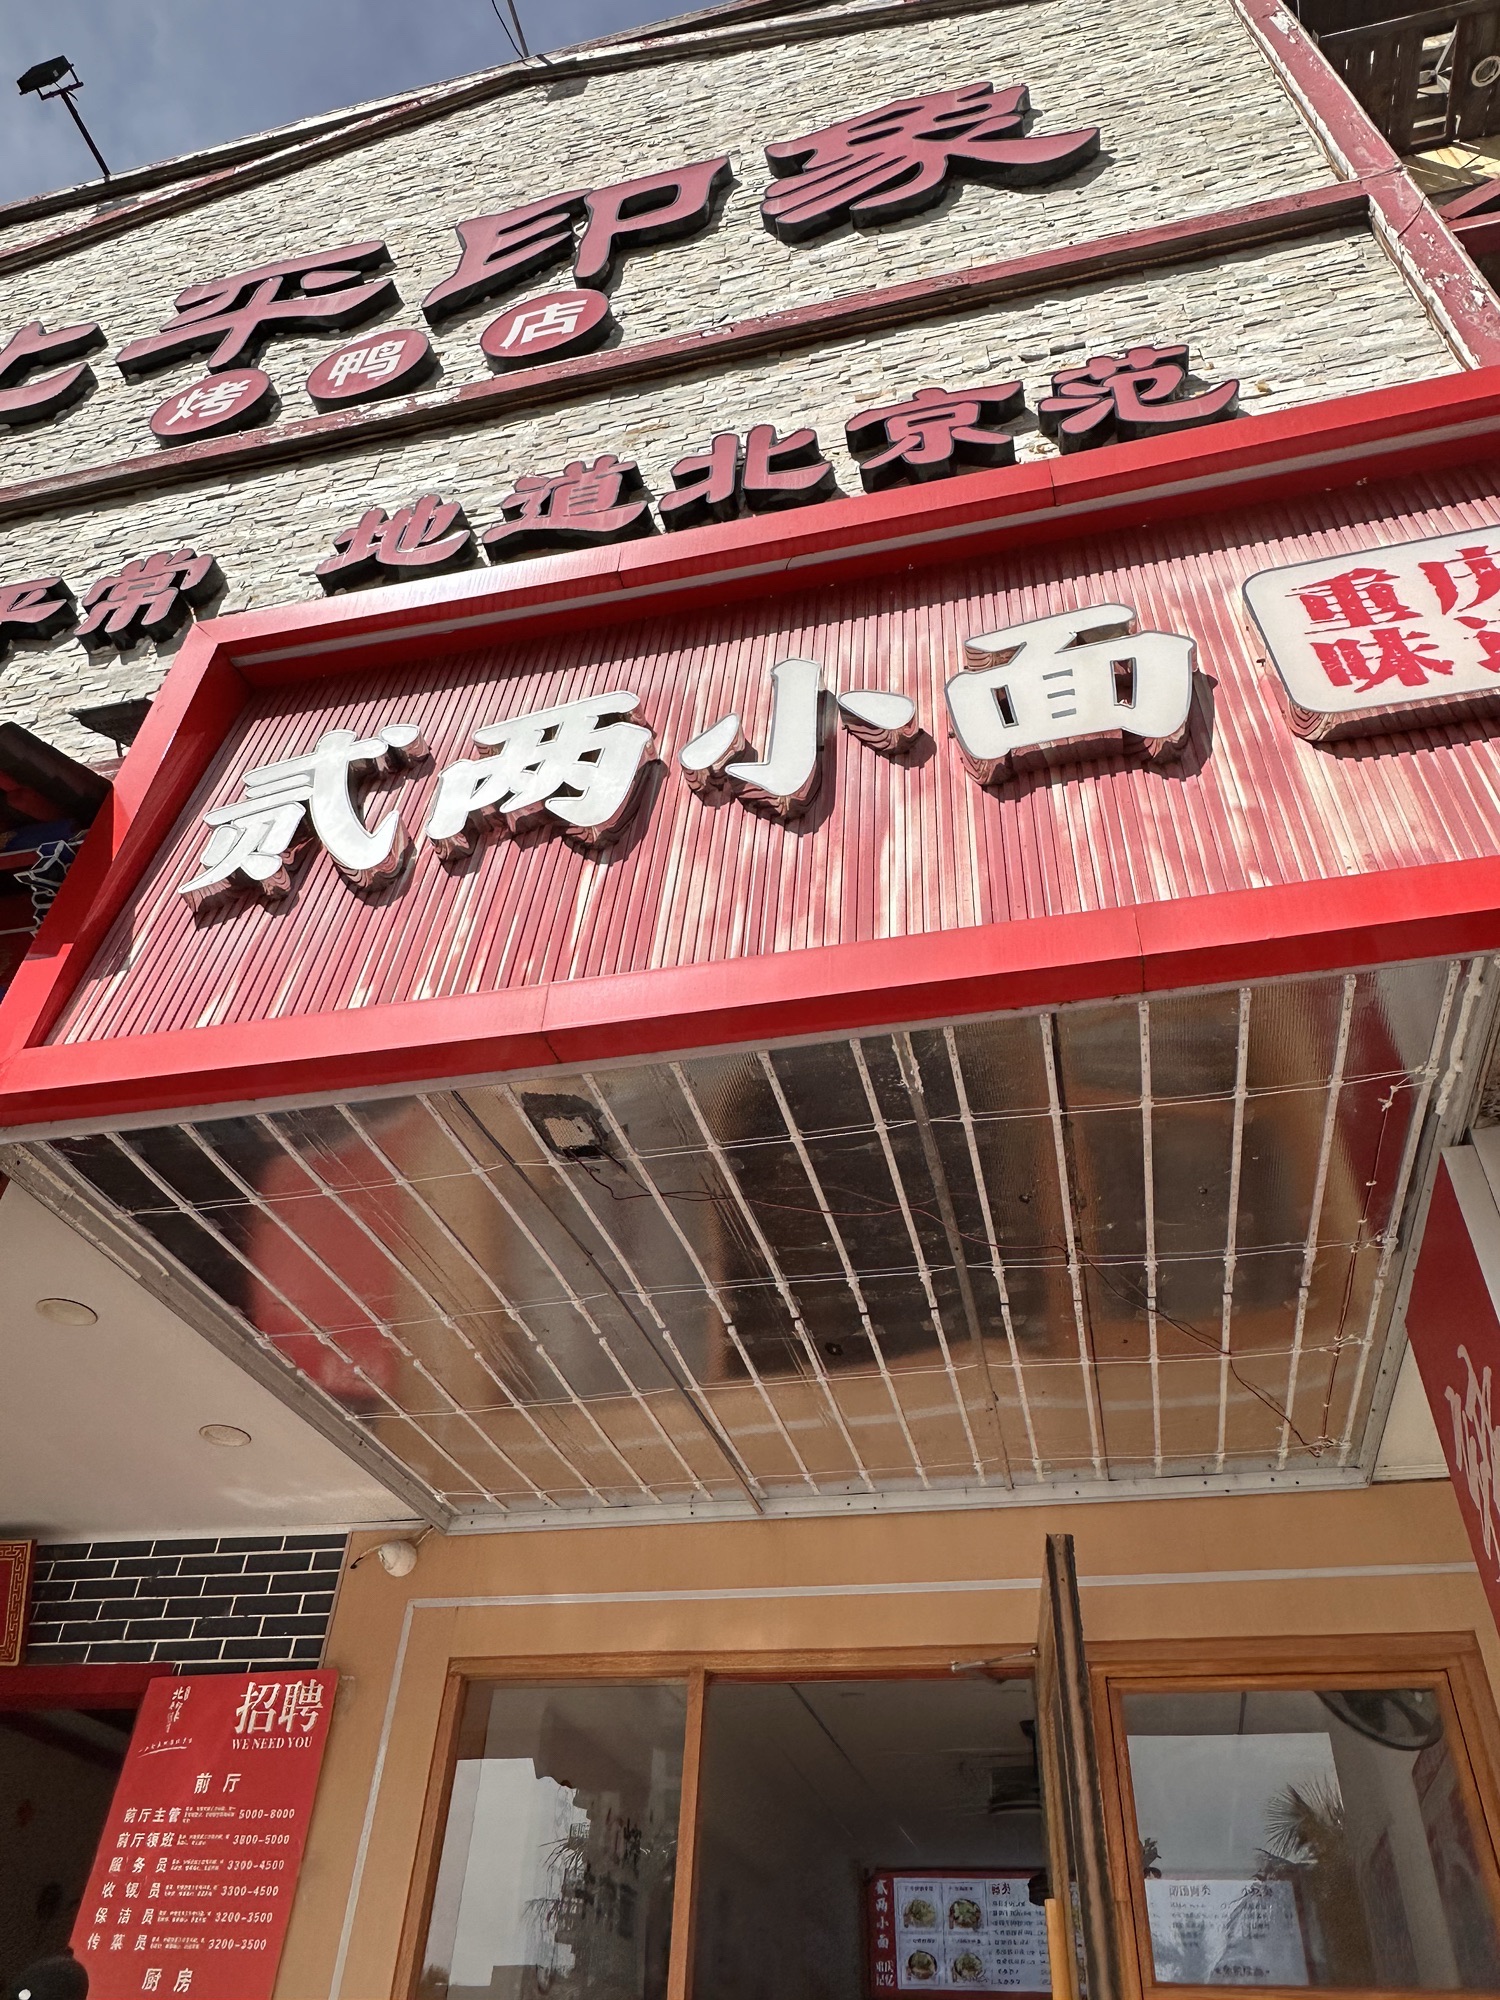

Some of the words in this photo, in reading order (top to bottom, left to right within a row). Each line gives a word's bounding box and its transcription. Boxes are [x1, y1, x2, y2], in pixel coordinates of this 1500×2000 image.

[166, 299, 588, 427] 烤鸭店
[315, 345, 1240, 578] 地道北京范
[178, 603, 1198, 894] 贰两小面
[235, 1679, 324, 1734] 招聘
[232, 1738, 250, 1750] WE
[253, 1737, 284, 1750] NEED
[288, 1736, 313, 1748] YOU
[194, 1772, 242, 1794] 前厅
[238, 1809, 295, 1820] 5000-8000
[232, 1834, 290, 1846] 3800-5000
[227, 1860, 285, 1871] 3300-4500
[220, 1885, 279, 1897] 3300-4500
[214, 1911, 273, 1923] 3200-3500
[208, 1938, 267, 1951] 3200-3500
[141, 1968, 193, 1992] 厨房
